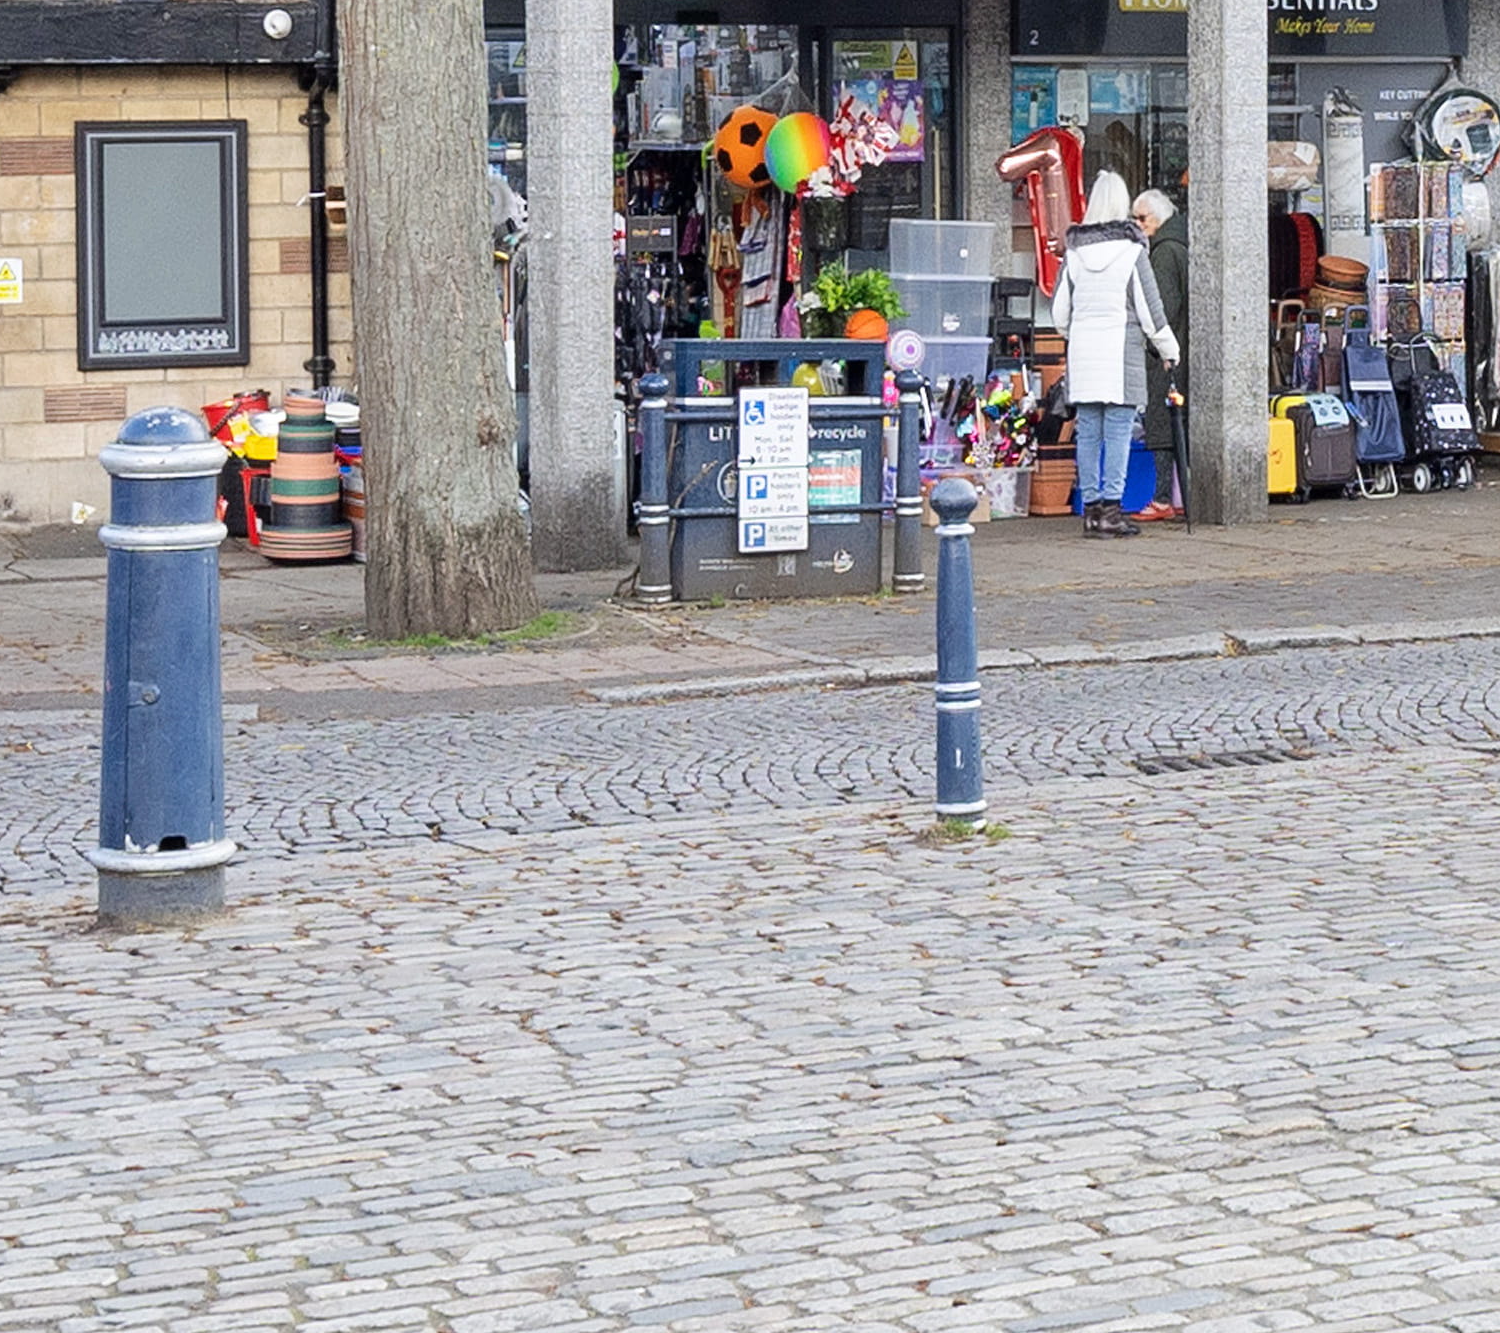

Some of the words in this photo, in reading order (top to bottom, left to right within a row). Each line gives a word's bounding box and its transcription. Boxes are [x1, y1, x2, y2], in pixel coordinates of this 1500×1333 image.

[1275, 16, 1312, 36] Makes
[1315, 17, 1340, 33] Your
[1343, 17, 1375, 33] Home
[1029, 30, 1039, 45] 2
[1401, 112, 1414, 121] YO
[817, 424, 867, 443] recycle
